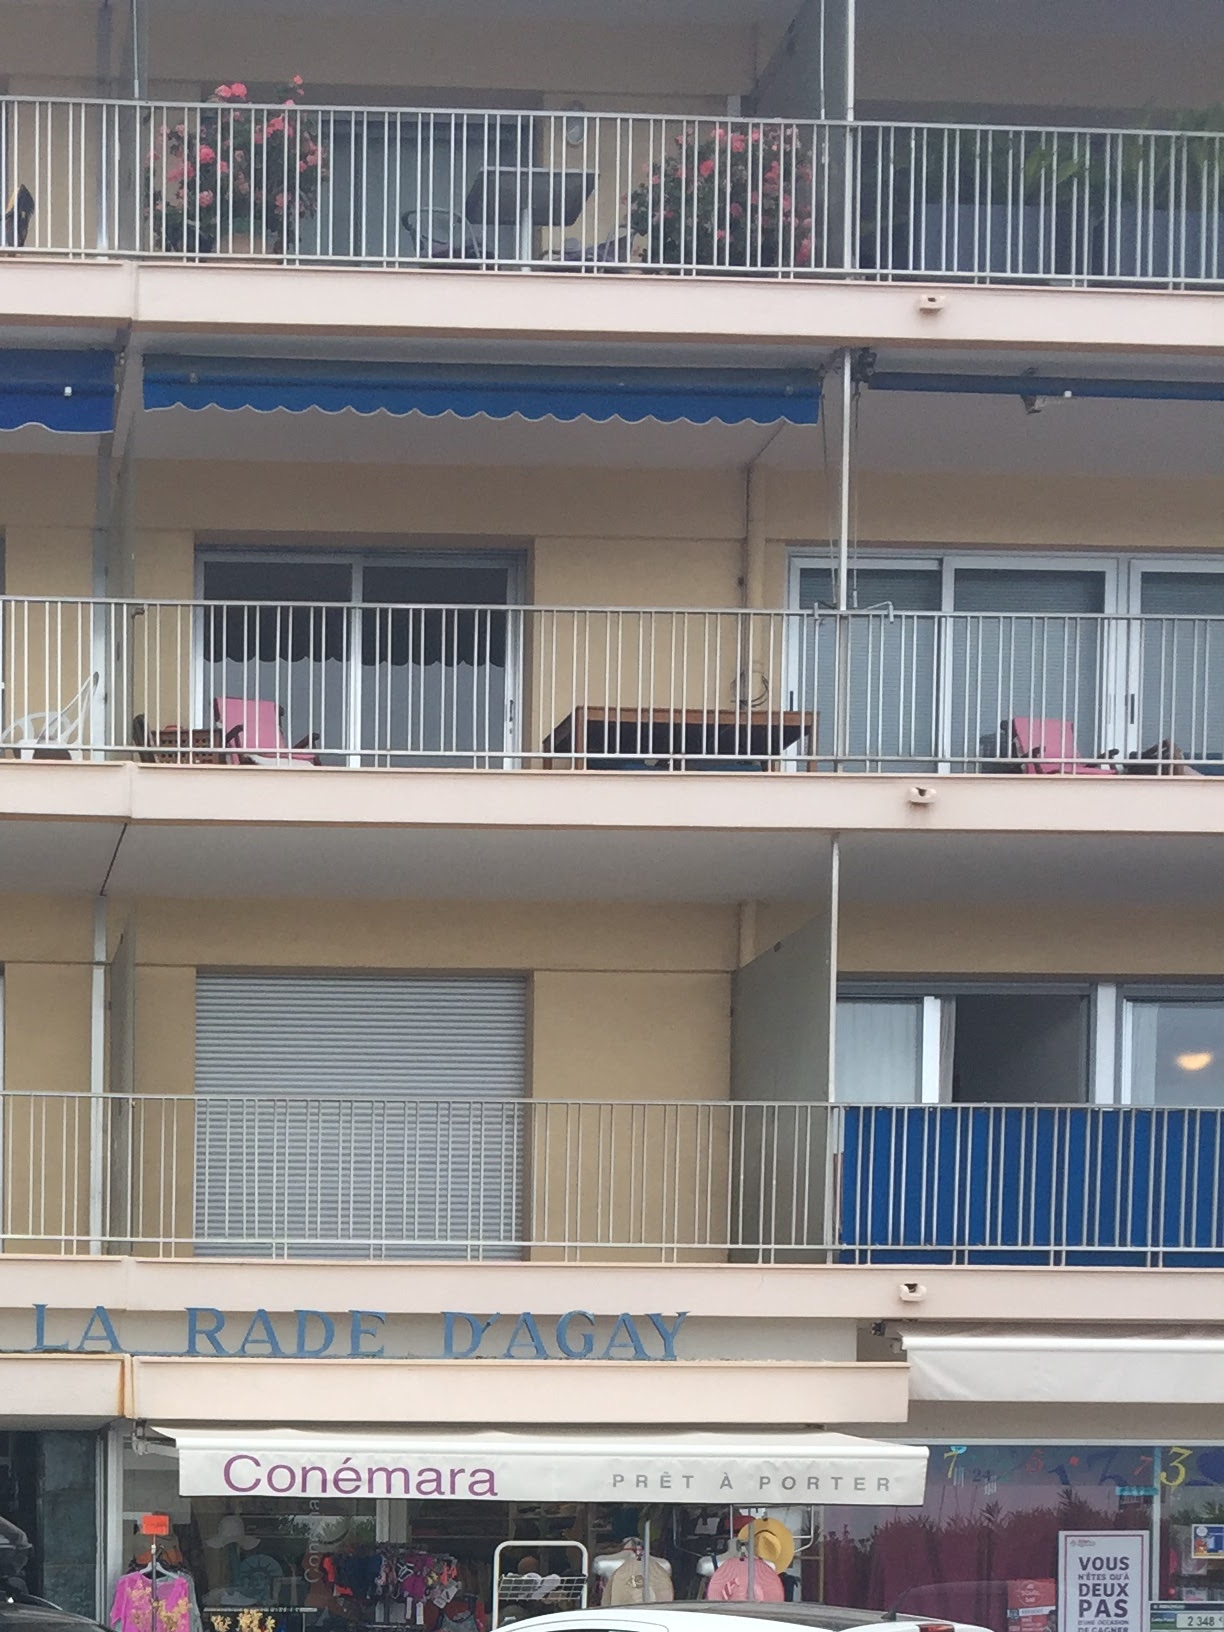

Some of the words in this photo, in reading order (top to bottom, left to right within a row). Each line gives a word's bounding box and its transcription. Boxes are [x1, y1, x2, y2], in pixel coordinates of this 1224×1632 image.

[32, 1303, 122, 1351] LA
[185, 1307, 387, 1356] RADE
[441, 1310, 691, 1359] D'AGAY
[223, 1454, 498, 1497] Conémara
[1160, 1446, 1193, 1486] 3
[612, 1472, 694, 1489] PRÊT
[720, 1472, 733, 1490] À
[759, 1475, 890, 1491] PORTER
[1078, 1556, 1130, 1571] VOUS
[1078, 1583, 1129, 1597] DEUX
[1078, 1599, 1128, 1618] PAS
[1196, 1615, 1216, 1627] 348
